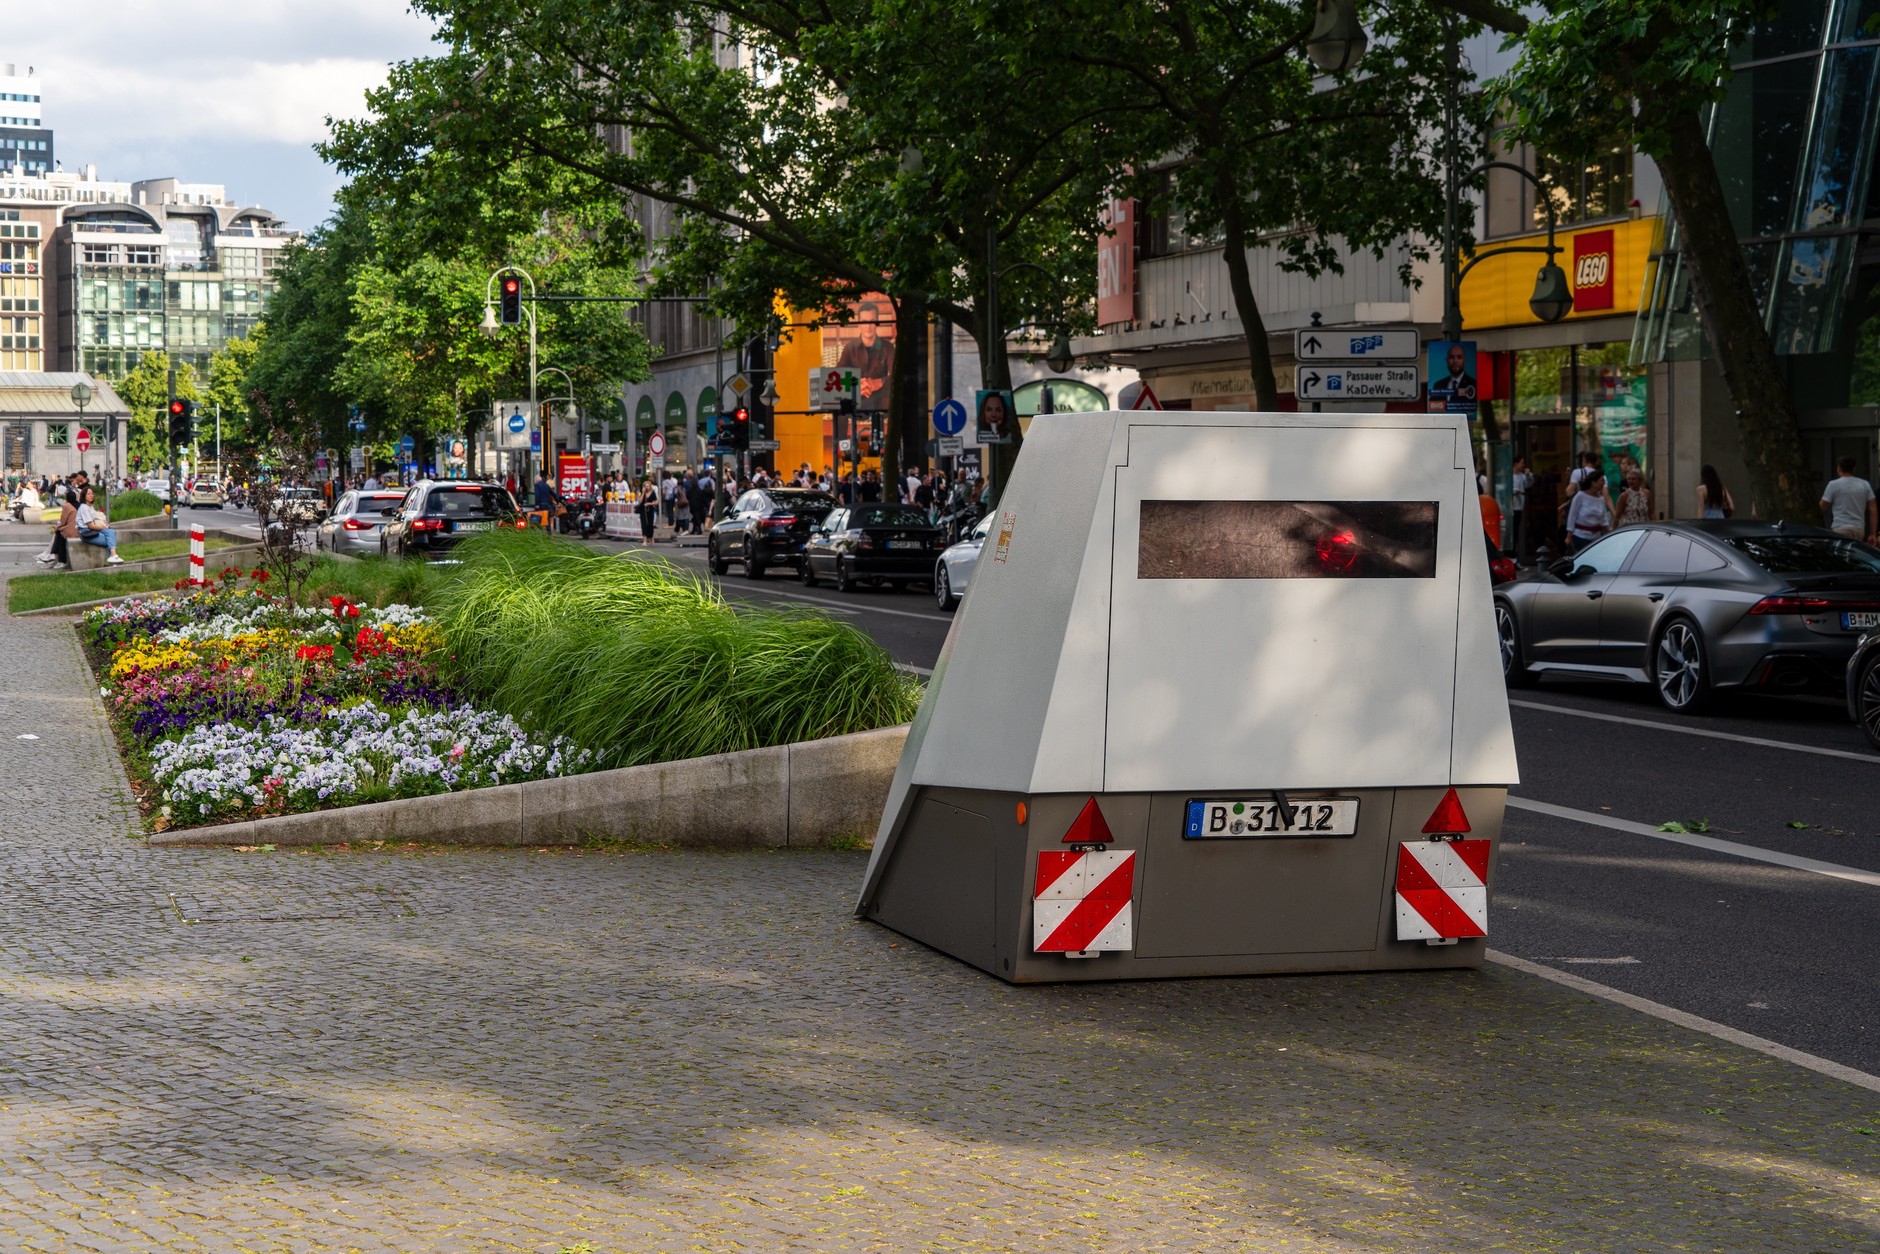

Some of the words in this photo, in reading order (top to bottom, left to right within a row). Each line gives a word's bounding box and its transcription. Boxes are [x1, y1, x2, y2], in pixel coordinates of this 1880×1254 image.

[1098, 241, 1128, 300] EN!
[1576, 254, 1608, 287] LEGO
[1346, 371, 1384, 381] Passauer
[1386, 371, 1414, 381] Straße
[1346, 384, 1392, 395] KaDeWe
[1037, 404, 1074, 412] PADA
[561, 477, 591, 491] SPD
[1849, 613, 1857, 626] B
[1864, 613, 1879, 626] AM
[1210, 806, 1227, 832] B
